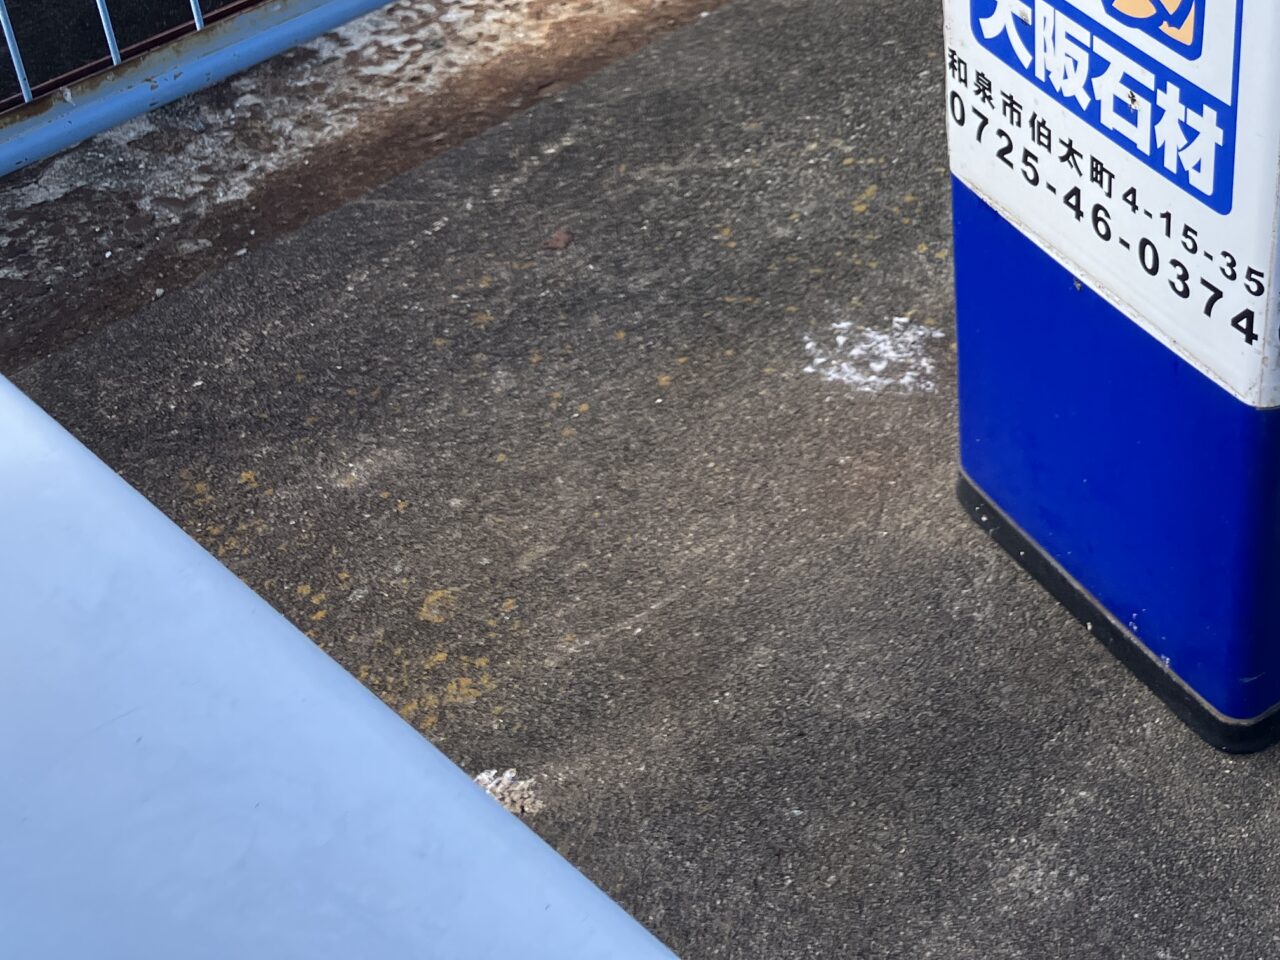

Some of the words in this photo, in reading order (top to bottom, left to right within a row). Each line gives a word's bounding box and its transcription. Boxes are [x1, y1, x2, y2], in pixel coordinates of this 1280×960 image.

[948, 47, 1265, 297] 和泉市伯太町4-15-35
[950, 90, 1259, 345] 0725-46-0374
